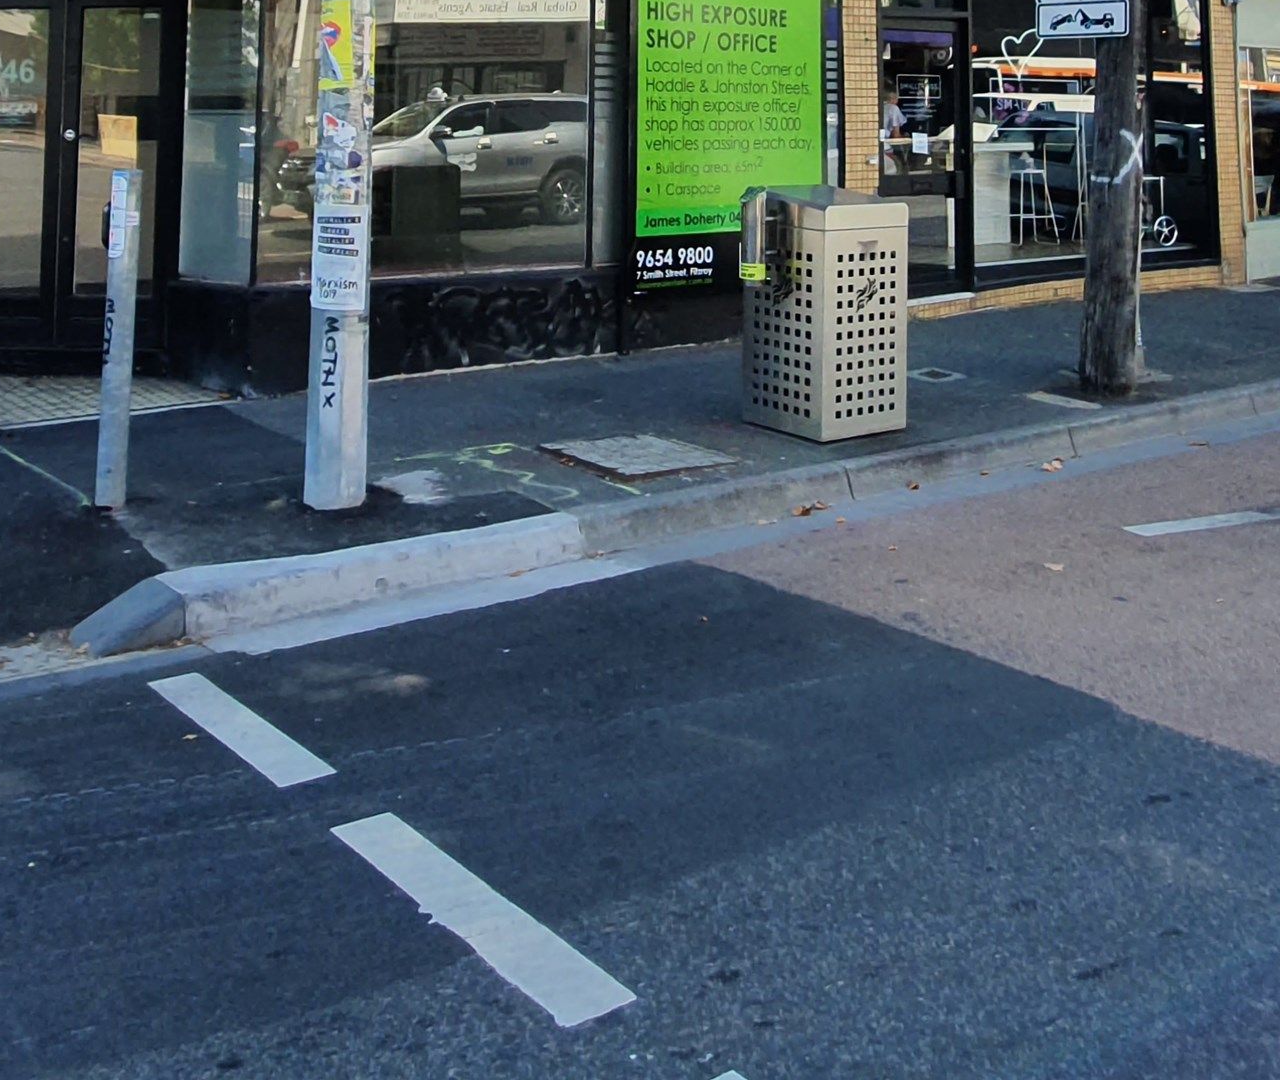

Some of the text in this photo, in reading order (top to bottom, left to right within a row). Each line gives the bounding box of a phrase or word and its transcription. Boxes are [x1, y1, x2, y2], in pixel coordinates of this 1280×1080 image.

[646, 1, 787, 27] HIGH EXPOSURE
[646, 28, 696, 49] SHOP
[717, 32, 777, 53] OFFICE
[645, 58, 702, 73] Located
[706, 62, 722, 74] on
[728, 61, 747, 75] the
[795, 62, 807, 76] of
[645, 78, 695, 92] Hoddle
[699, 79, 709, 92] &
[713, 79, 768, 93] Johnston
[646, 97, 667, 112] this
[670, 98, 699, 115] high
[703, 101, 759, 115] exposure
[645, 119, 678, 133] shop
[682, 119, 705, 132] has
[709, 121, 754, 133] approx
[645, 136, 699, 151] vehicles
[703, 136, 749, 153] passing
[753, 136, 786, 150] each
[656, 163, 699, 176] Building
[665, 184, 720, 196] Carspace
[644, 217, 680, 228] James
[684, 212, 726, 227] Doherty
[636, 246, 714, 268] 9654 9800
[315, 276, 358, 290] Marxism
[643, 270, 664, 280] Smith
